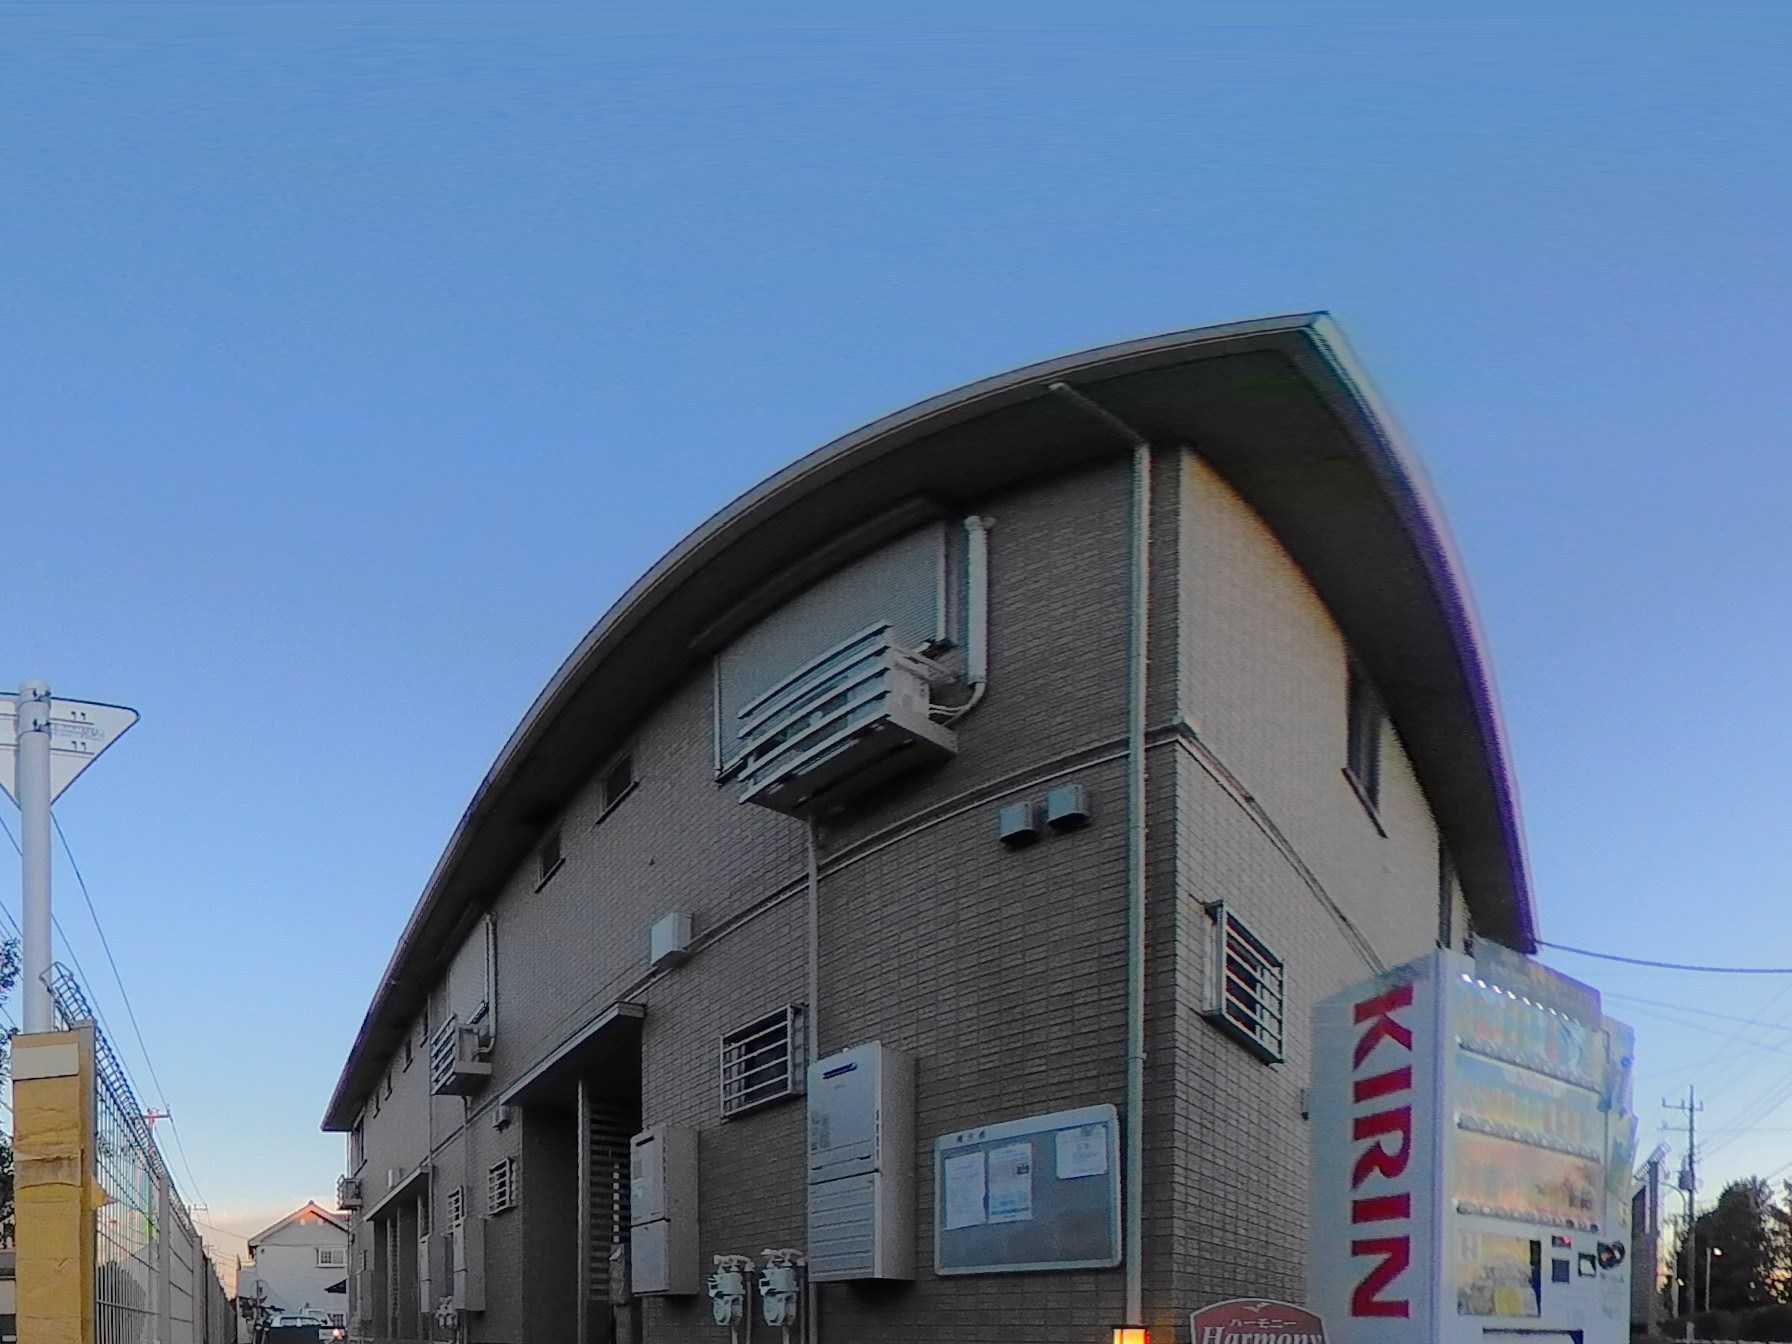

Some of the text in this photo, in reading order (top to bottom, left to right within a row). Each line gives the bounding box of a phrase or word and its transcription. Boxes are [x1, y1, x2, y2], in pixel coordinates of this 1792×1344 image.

[1352, 985, 1413, 1319] KIRIN
[1231, 1318, 1297, 1329] ハーモニー
